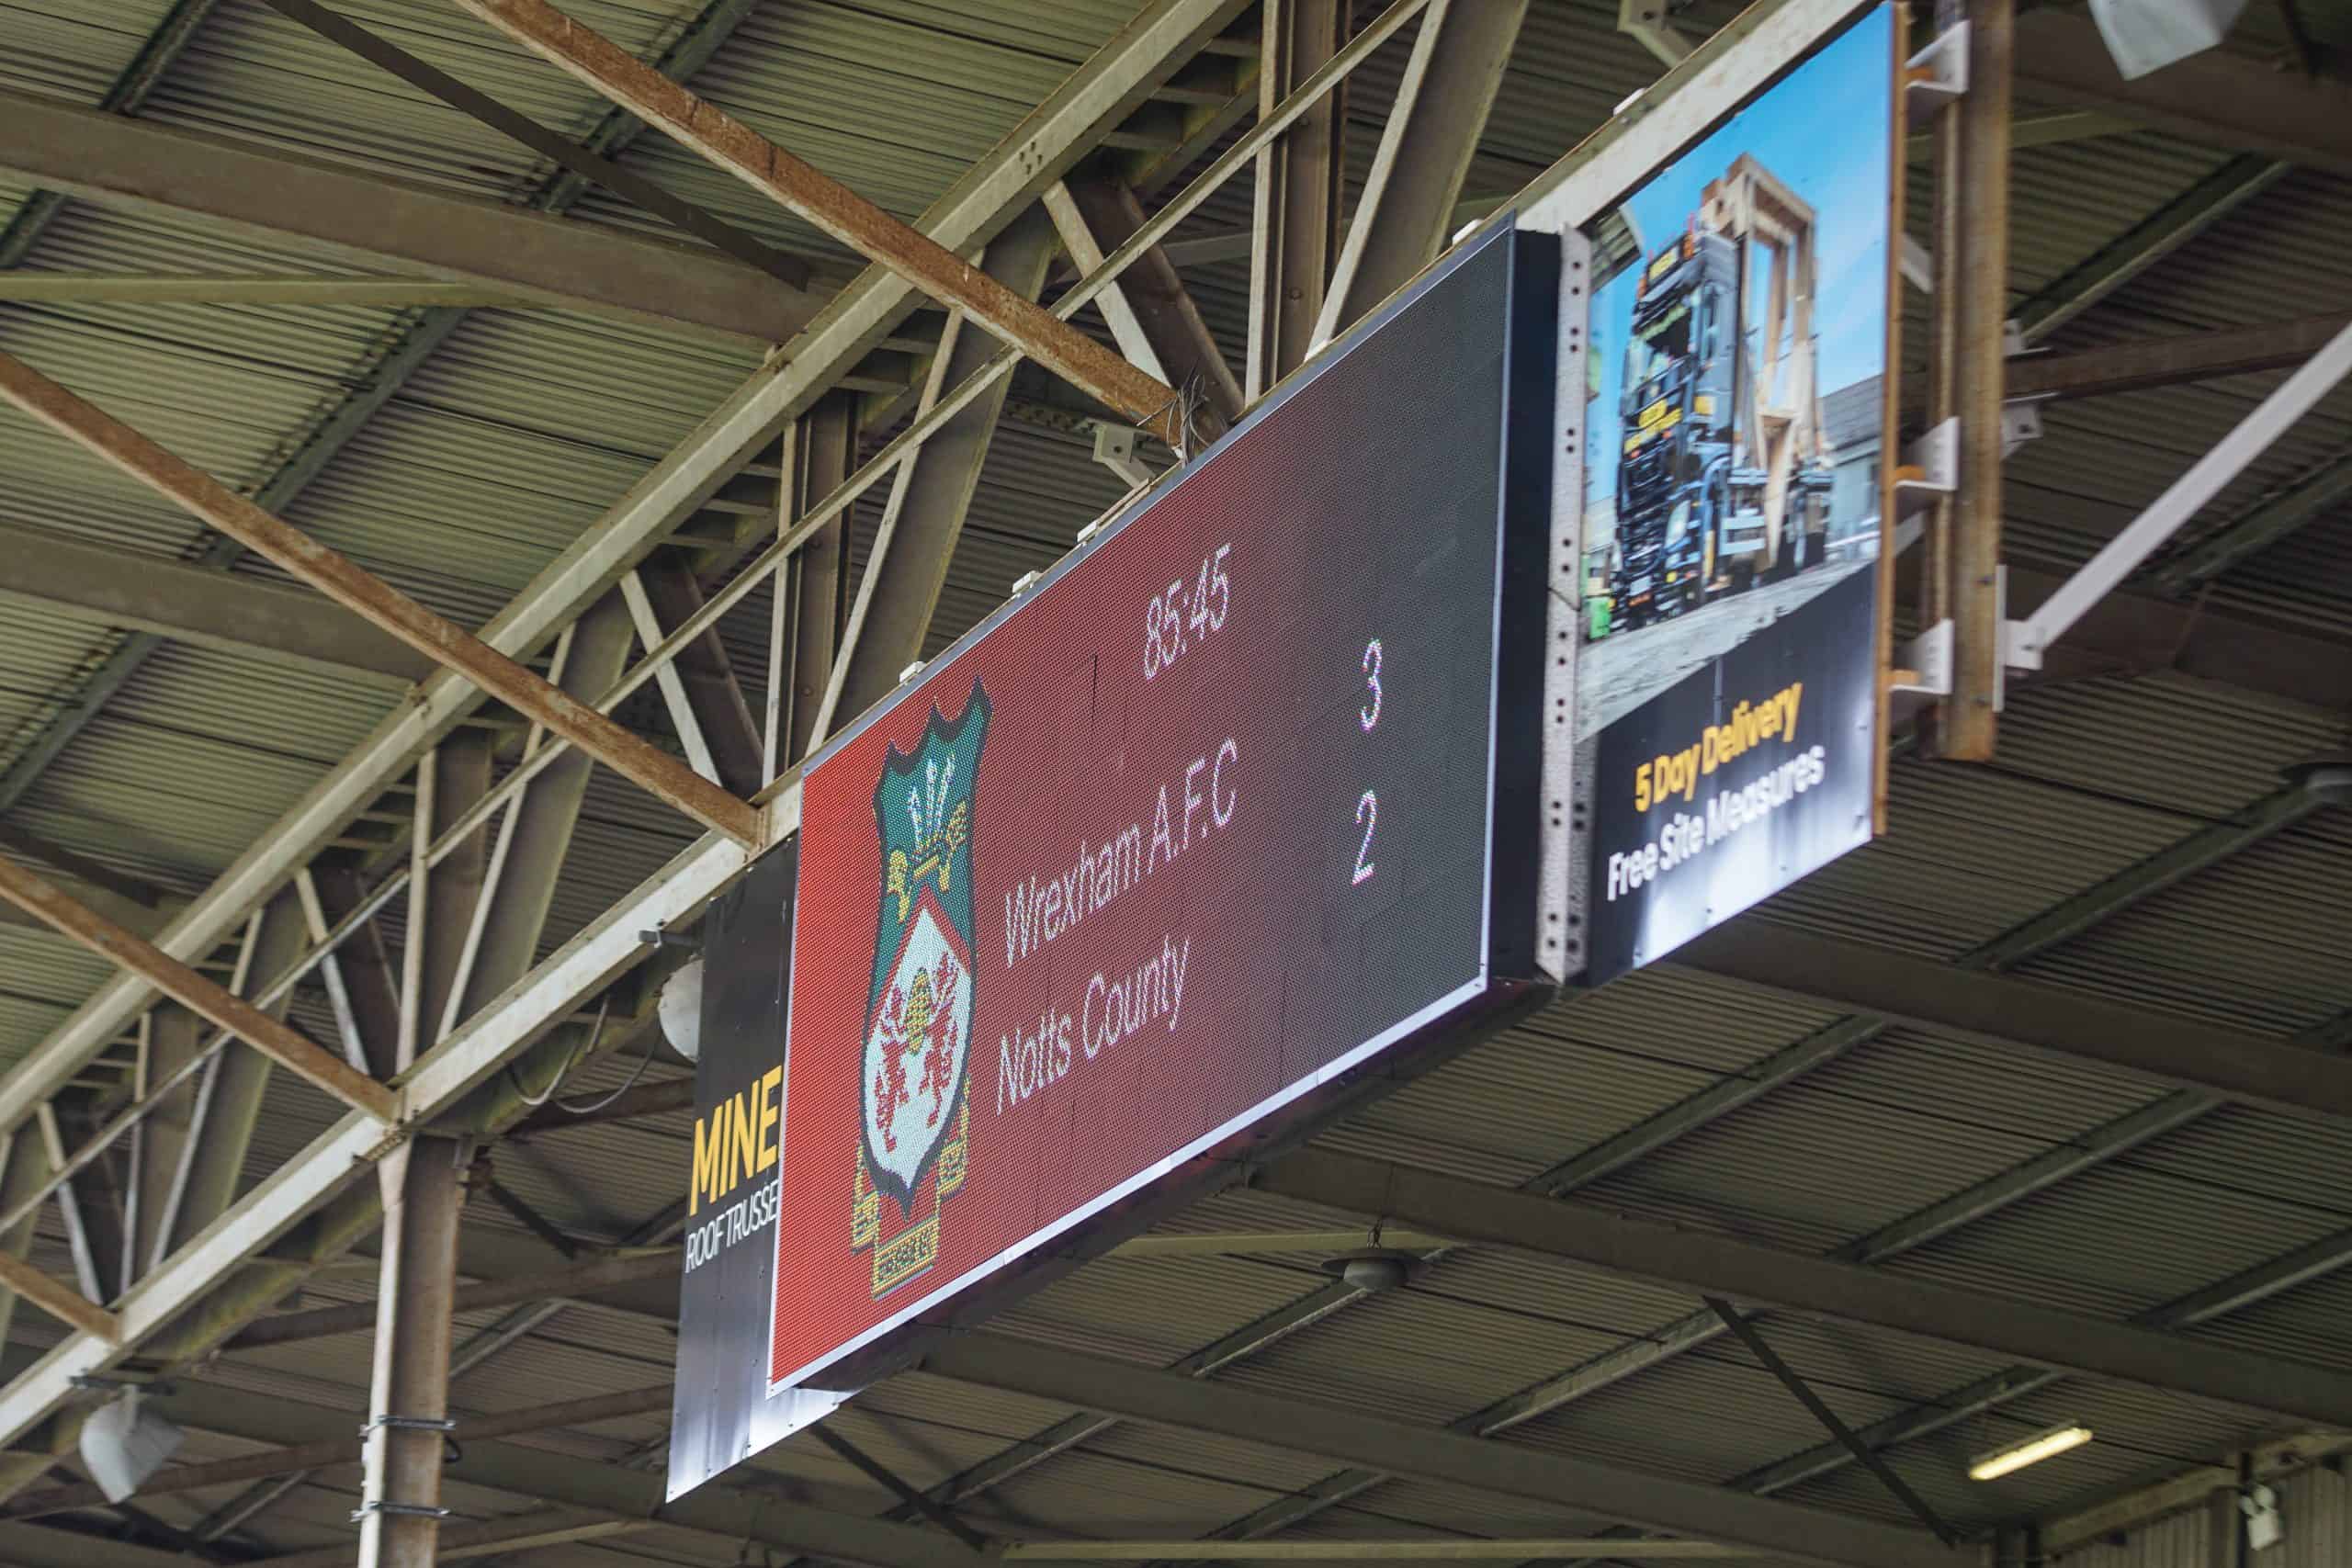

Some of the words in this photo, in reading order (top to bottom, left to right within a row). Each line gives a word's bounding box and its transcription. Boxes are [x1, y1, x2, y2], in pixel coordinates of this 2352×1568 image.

[1144, 543, 1231, 681] 85:45
[1361, 638, 1383, 733] 3
[1634, 763, 1653, 812] 5
[1654, 742, 1702, 804] Day
[1702, 682, 1804, 775] Delivery
[1005, 821, 1141, 969] Wrexham
[1148, 737, 1238, 874] A.F.C
[1351, 789, 1377, 886] 2
[1607, 841, 1658, 902] Free
[1660, 813, 1705, 872] Site
[1706, 745, 1826, 845] Measures
[996, 1008, 1072, 1118] Notts
[1082, 933, 1190, 1061] County
[689, 1065, 783, 1217] MINE
[684, 1213, 726, 1274] ROOF
